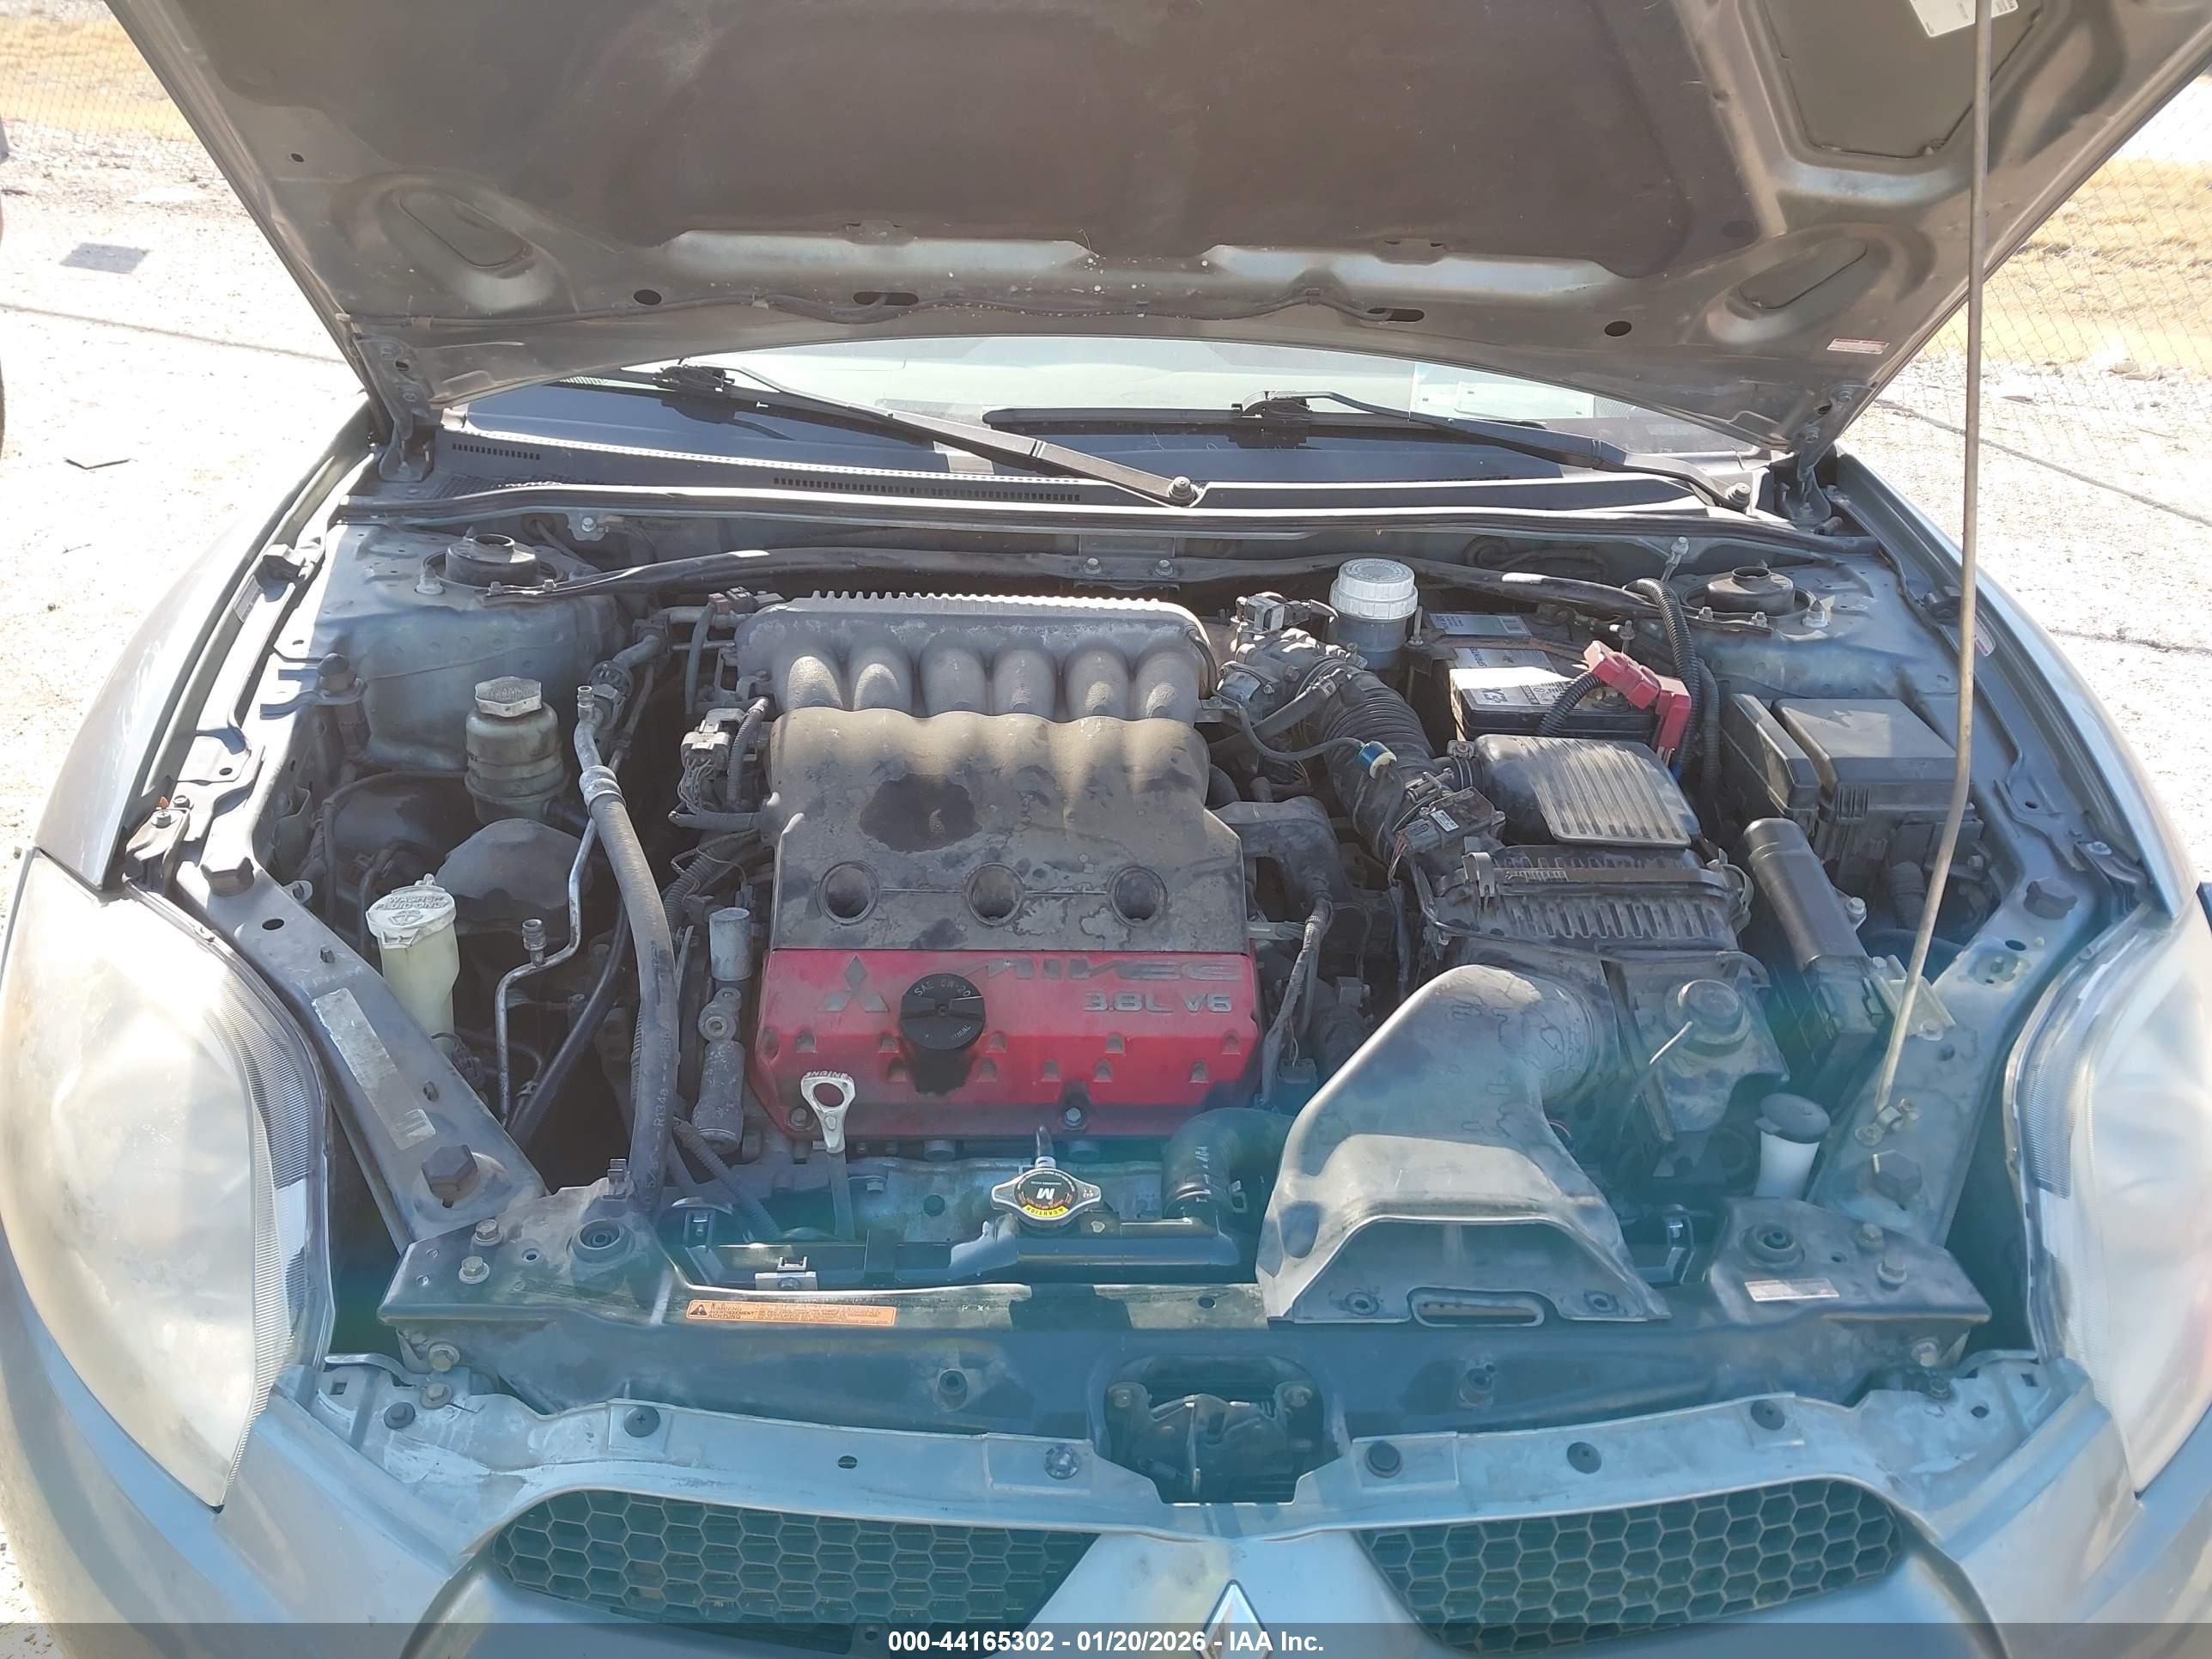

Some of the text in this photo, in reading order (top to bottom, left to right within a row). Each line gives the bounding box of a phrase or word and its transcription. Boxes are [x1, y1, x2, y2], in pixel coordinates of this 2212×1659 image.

[914, 980, 935, 996] SAE
[1082, 992, 1232, 1014] 3.8L V6
[951, 1024, 971, 1039] ANUAL
[653, 1087, 669, 1127] R134a
